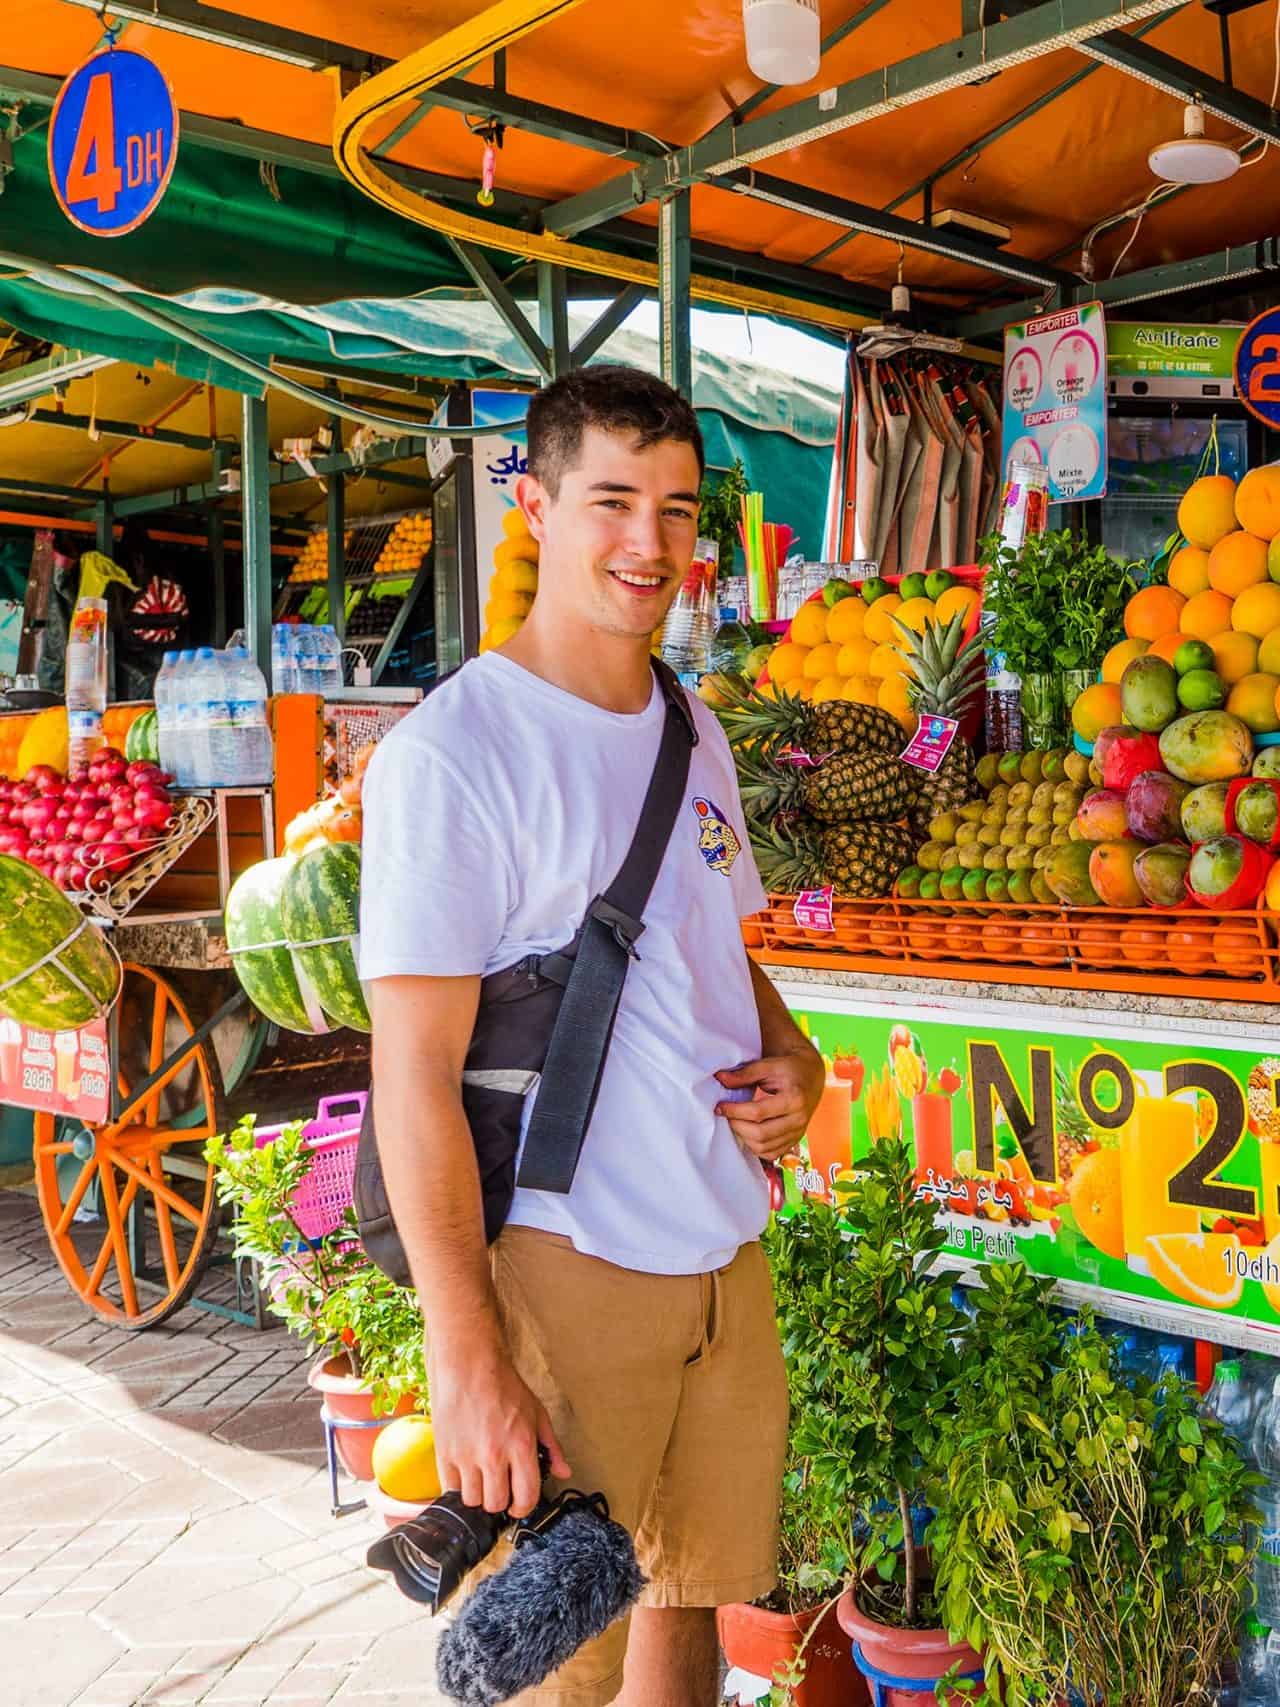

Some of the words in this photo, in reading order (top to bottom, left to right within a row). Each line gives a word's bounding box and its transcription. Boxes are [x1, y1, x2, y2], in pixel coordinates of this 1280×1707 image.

[65, 72, 122, 213] 4
[127, 129, 163, 189] DH
[1028, 313, 1078, 335] EMPORTER
[1025, 406, 1078, 427] EMPORTER
[972, 1225, 1016, 1258] Petit
[1224, 1248, 1280, 1284] 10dh
